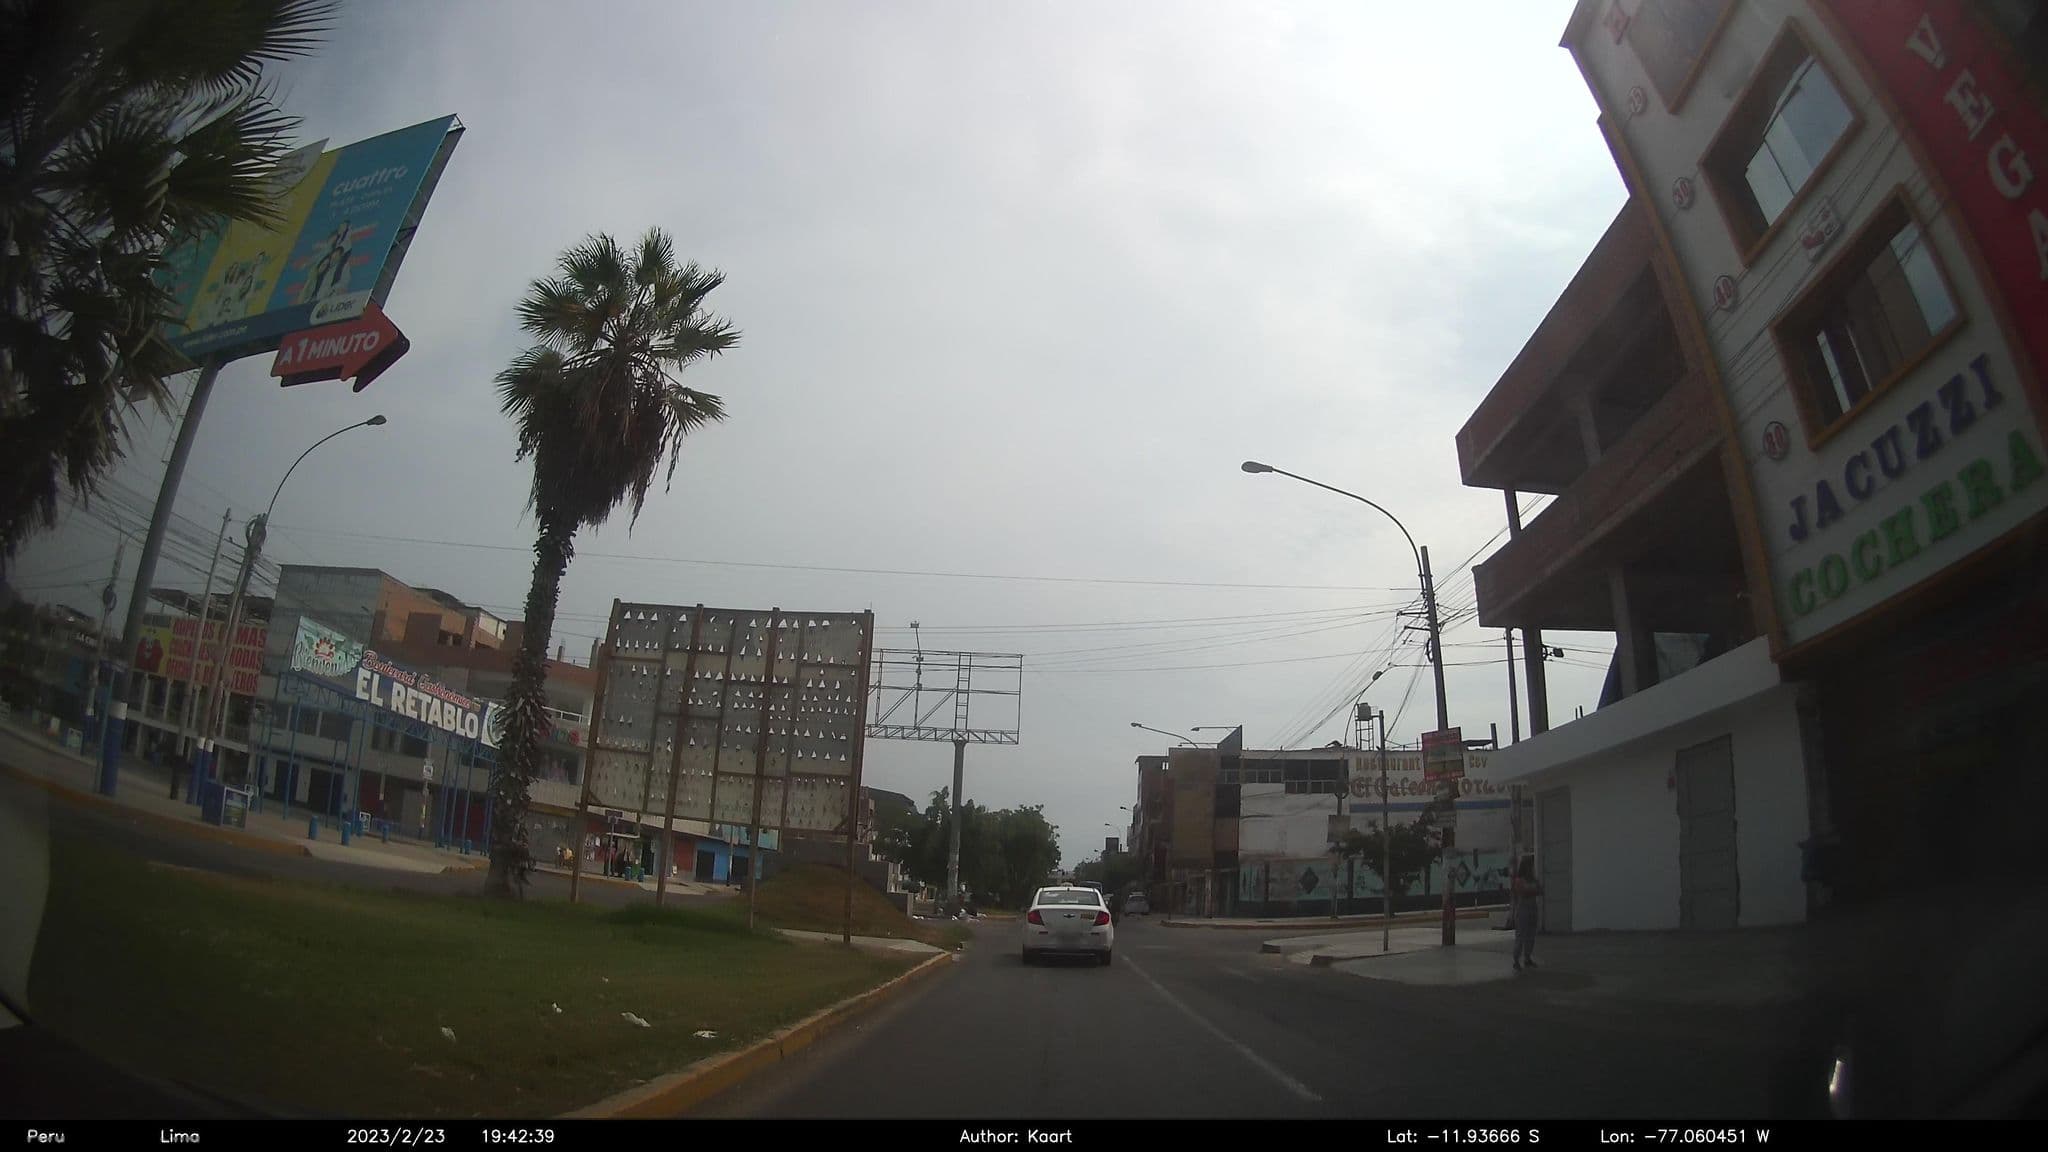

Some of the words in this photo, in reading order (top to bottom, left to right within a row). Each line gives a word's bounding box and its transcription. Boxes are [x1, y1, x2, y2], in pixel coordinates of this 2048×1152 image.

[307, 330, 381, 361] MINUTO
[1789, 353, 2005, 541] JACUZZI
[1790, 430, 2044, 616] COCHERA
[356, 667, 384, 708] EL
[391, 681, 479, 740] RETABLO
